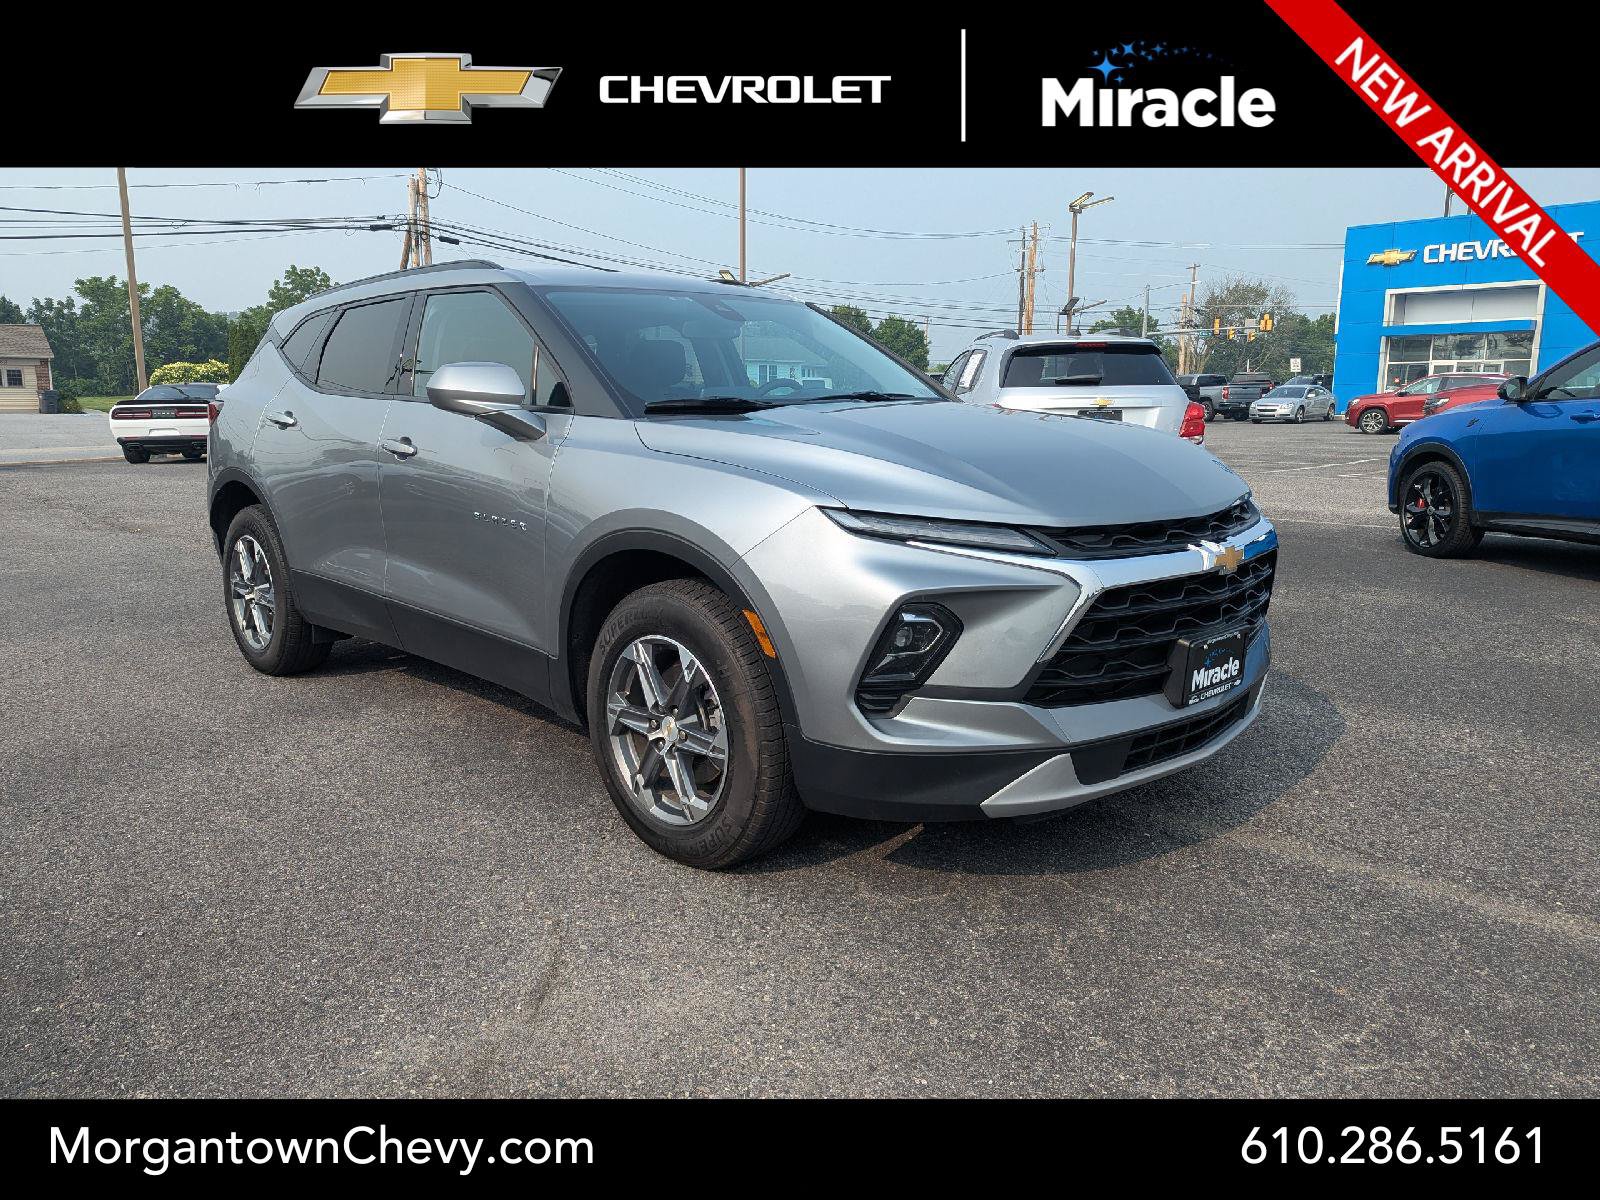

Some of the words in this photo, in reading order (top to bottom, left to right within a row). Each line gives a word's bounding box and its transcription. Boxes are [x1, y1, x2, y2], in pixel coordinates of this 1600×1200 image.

[1423, 231, 1585, 264] CHEVRT
[1191, 656, 1240, 692] Miracle
[1200, 682, 1233, 700] CHEVROLET
